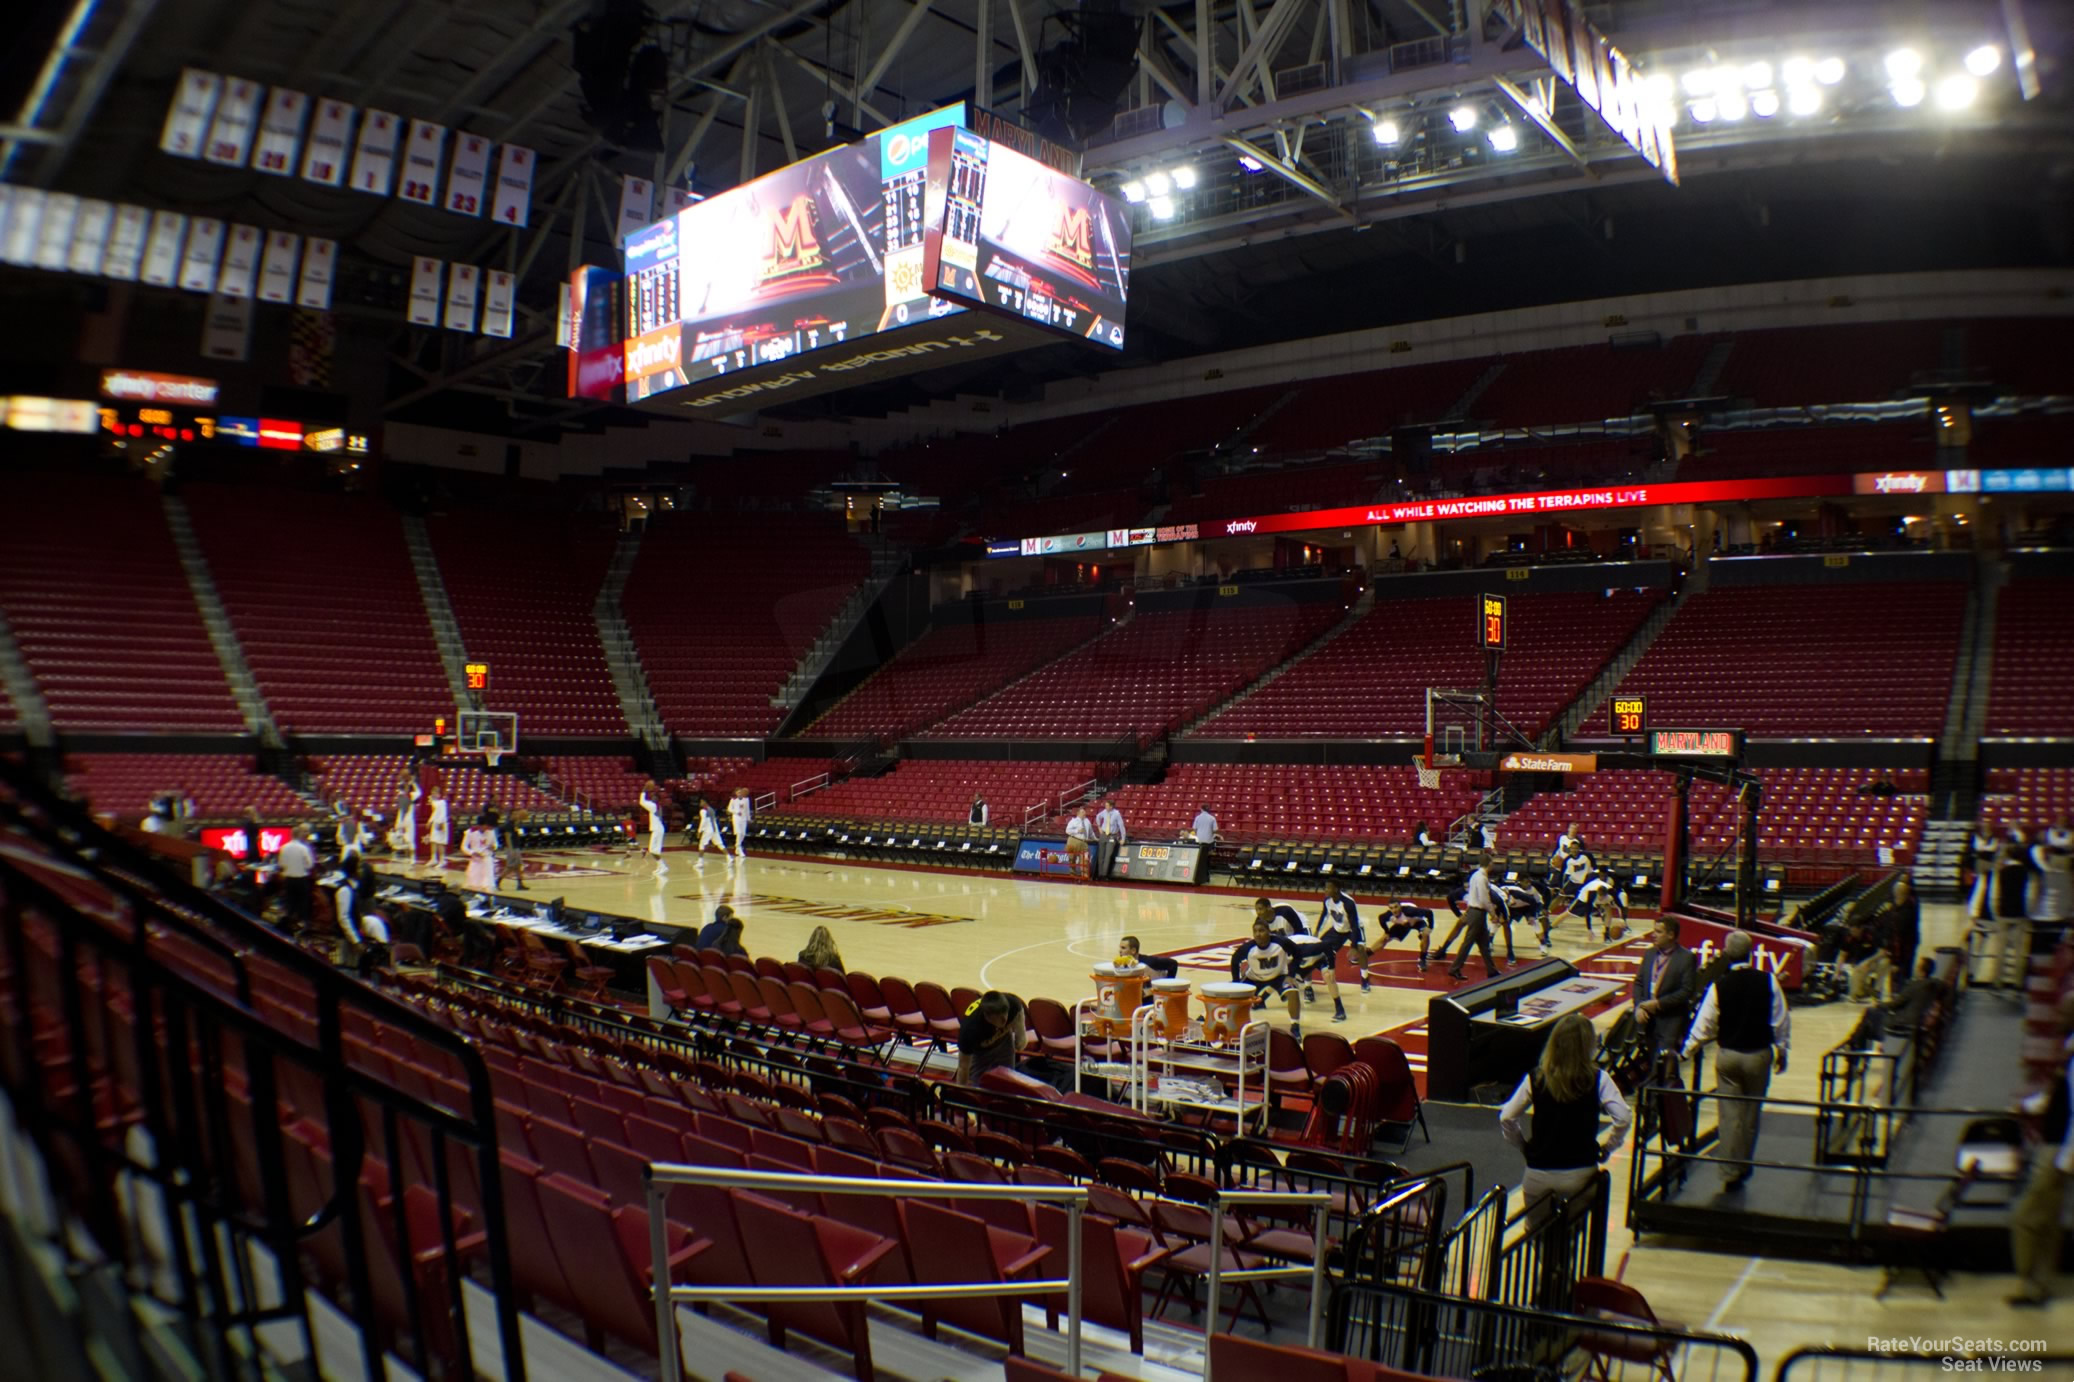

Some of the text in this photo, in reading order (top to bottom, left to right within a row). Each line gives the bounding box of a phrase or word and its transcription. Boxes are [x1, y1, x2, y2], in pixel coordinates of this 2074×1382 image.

[974, 107, 1074, 176] MARYLAND
[405, 180, 430, 201] 22
[453, 192, 478, 213] 23
[505, 206, 517, 223] 4
[897, 303, 908, 323] 0
[627, 335, 681, 374] xfinity
[157, 381, 217, 401] center
[1875, 473, 1928, 494] xfinity
[1367, 490, 1647, 520] ALL WHILE WATCHING THE TERRAPINS LIVE
[1226, 521, 1257, 534] xfinity
[1026, 539, 1036, 553] M
[1113, 531, 1123, 545] M
[1510, 570, 1525, 578] 114
[1488, 616, 1500, 642] 30
[467, 673, 485, 689] 30
[1615, 701, 1643, 713] 60:00
[1621, 714, 1639, 730] 30
[1657, 732, 1731, 749] MARYLAND
[1021, 849, 1034, 860] The
[1141, 847, 1168, 857] 60:00
[1121, 863, 1129, 874] 0
[1100, 985, 1115, 1006] G
[1155, 999, 1164, 1012] G
[1213, 1007, 1228, 1023] G
